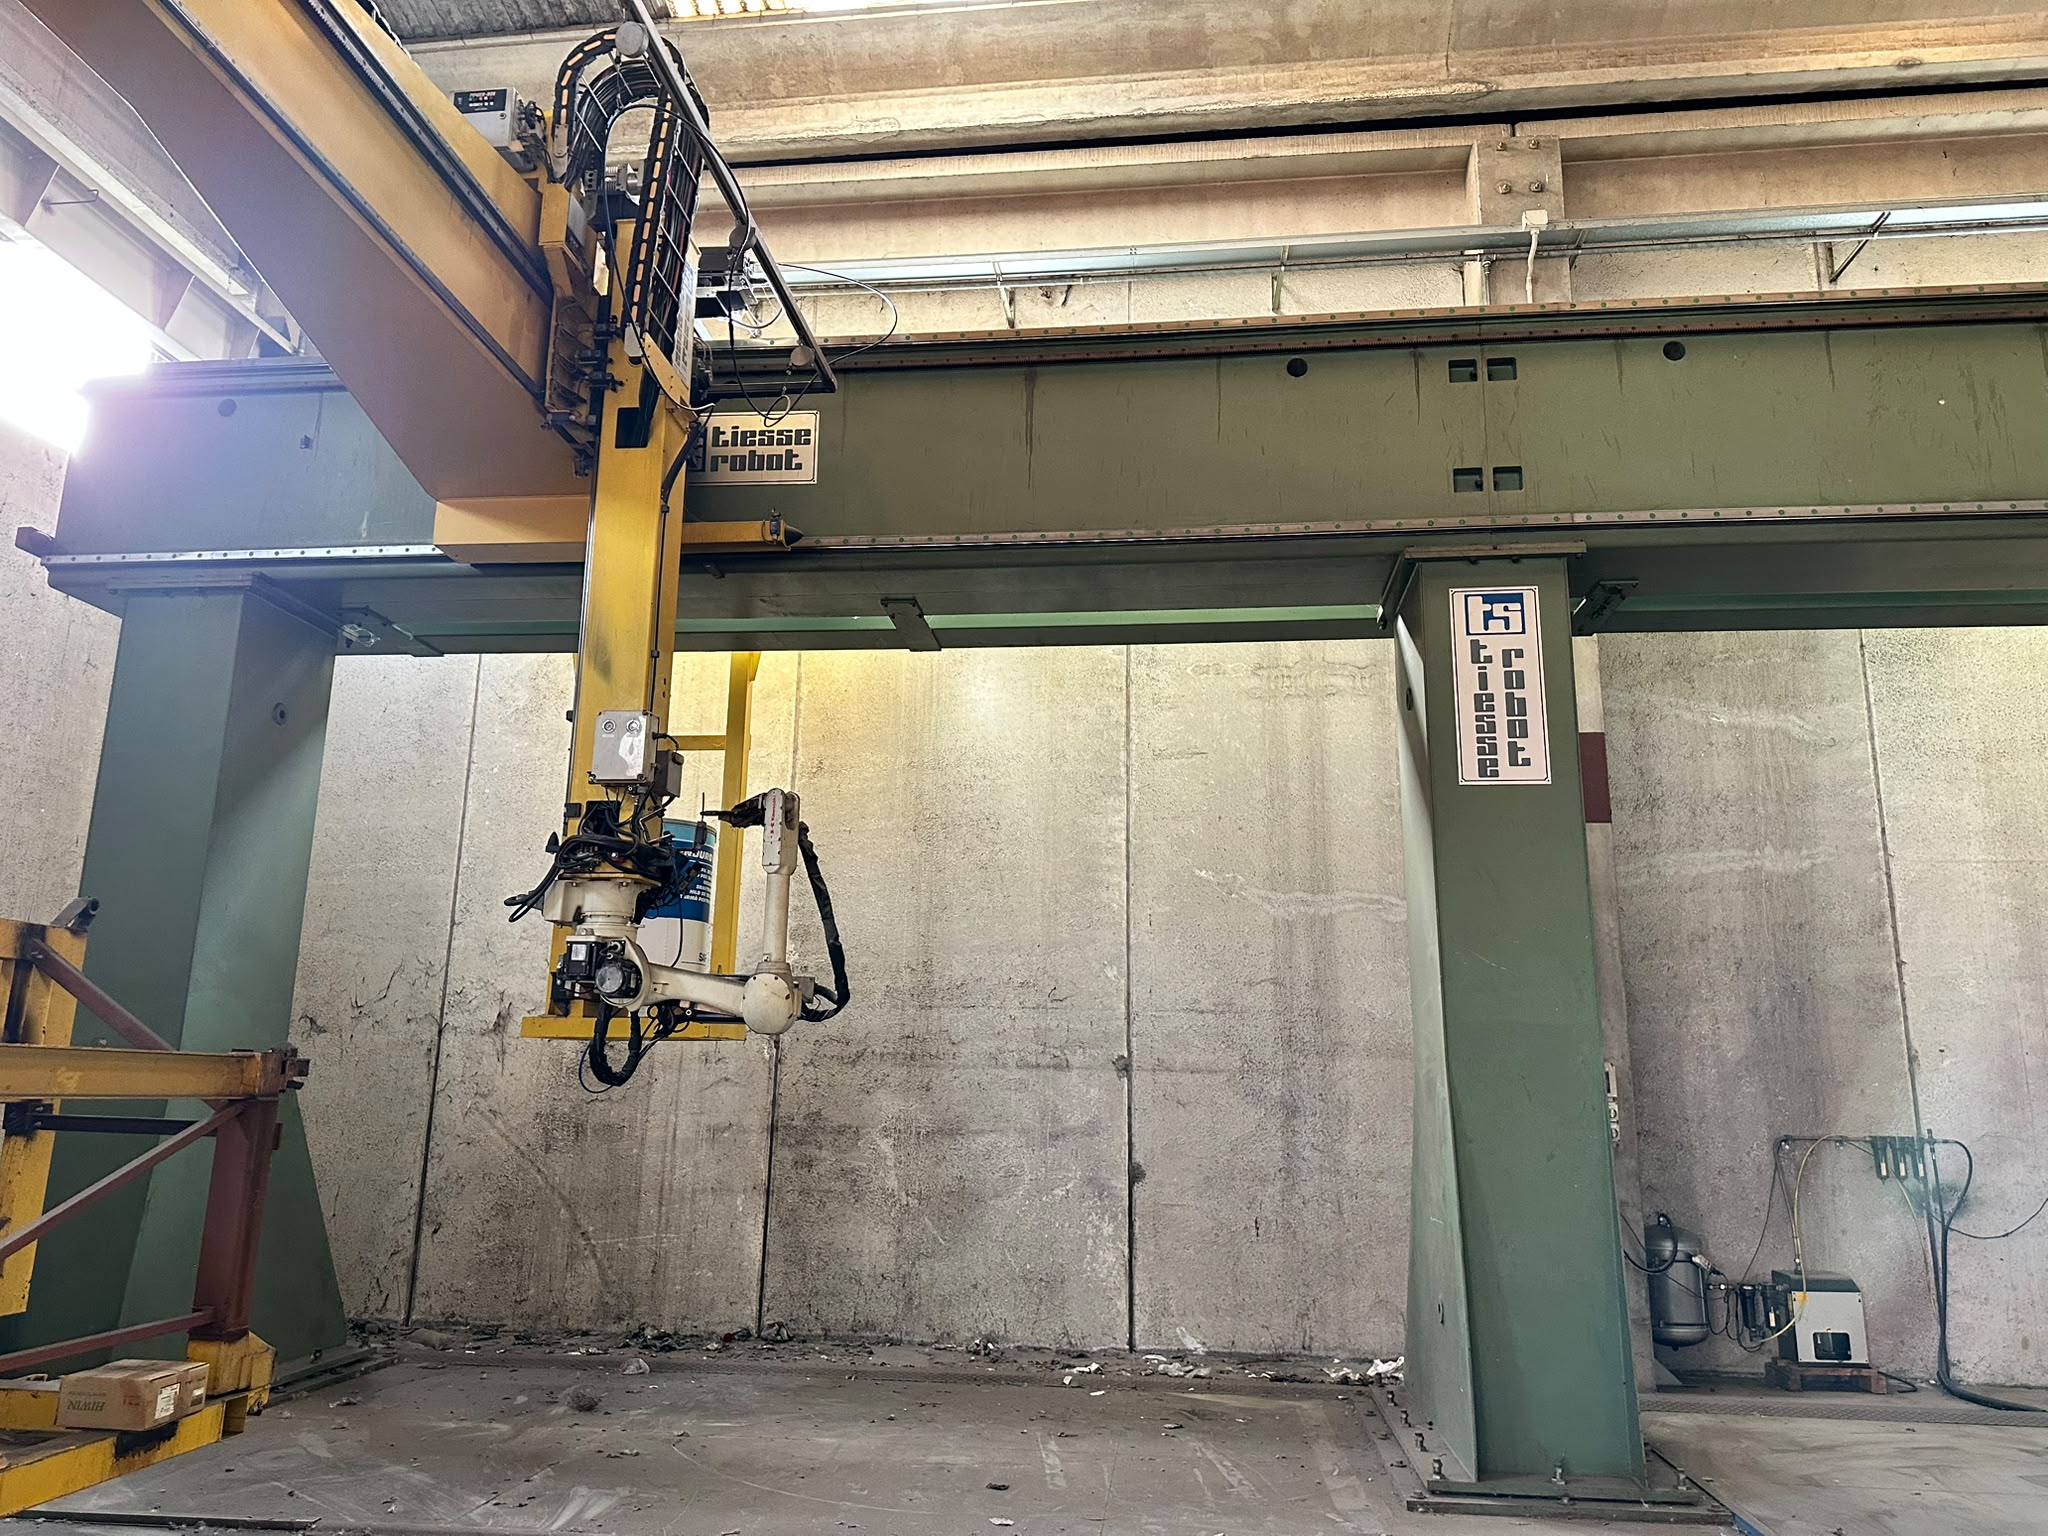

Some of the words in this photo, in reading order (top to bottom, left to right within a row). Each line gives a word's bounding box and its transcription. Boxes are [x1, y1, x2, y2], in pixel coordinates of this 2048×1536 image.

[711, 425, 811, 447] tiesse
[710, 449, 803, 472] robot
[1470, 639, 1499, 778] tiesse
[1502, 649, 1531, 767] robot
[66, 1399, 105, 1412] HIWIN
